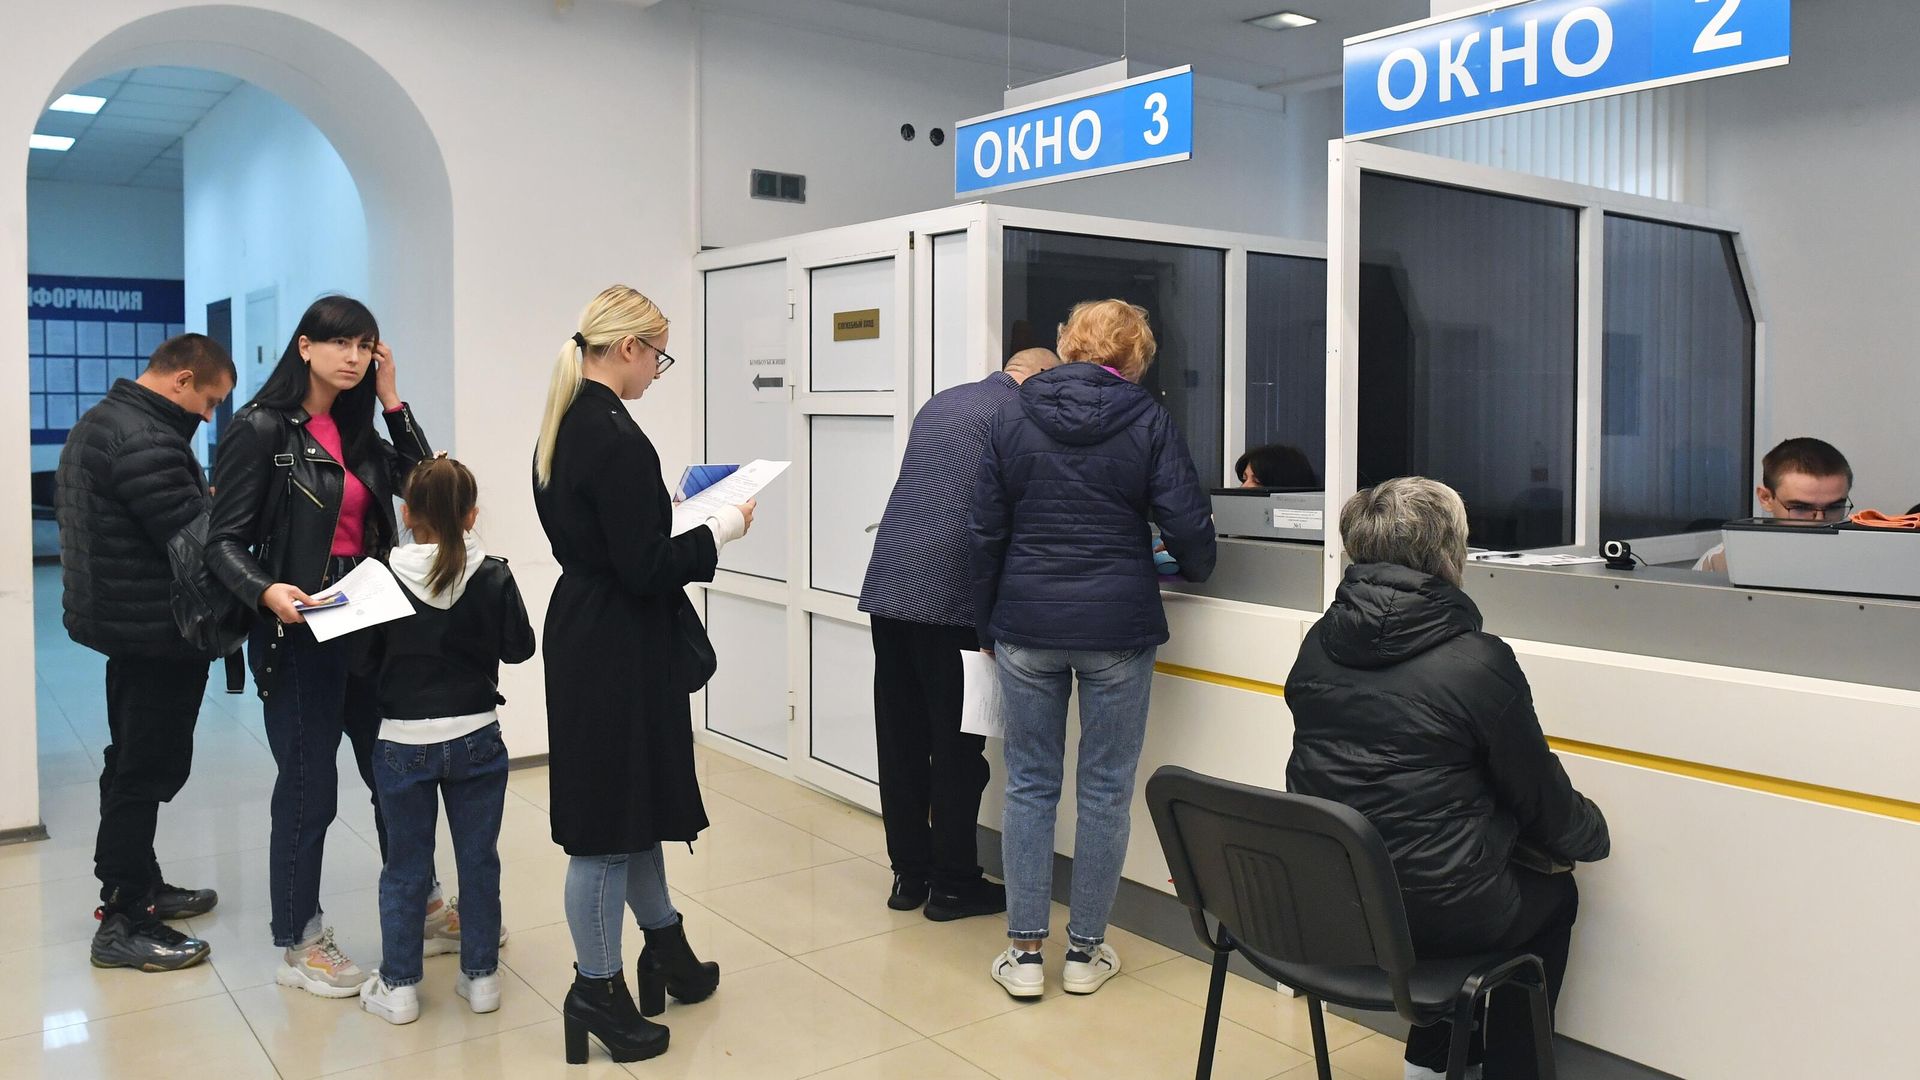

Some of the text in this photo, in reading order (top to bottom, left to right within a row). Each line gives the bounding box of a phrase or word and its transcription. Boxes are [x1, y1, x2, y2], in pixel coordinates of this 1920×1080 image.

[1377, 0, 1742, 111] ОКНО 2
[973, 91, 1169, 179] ОКНО 3
